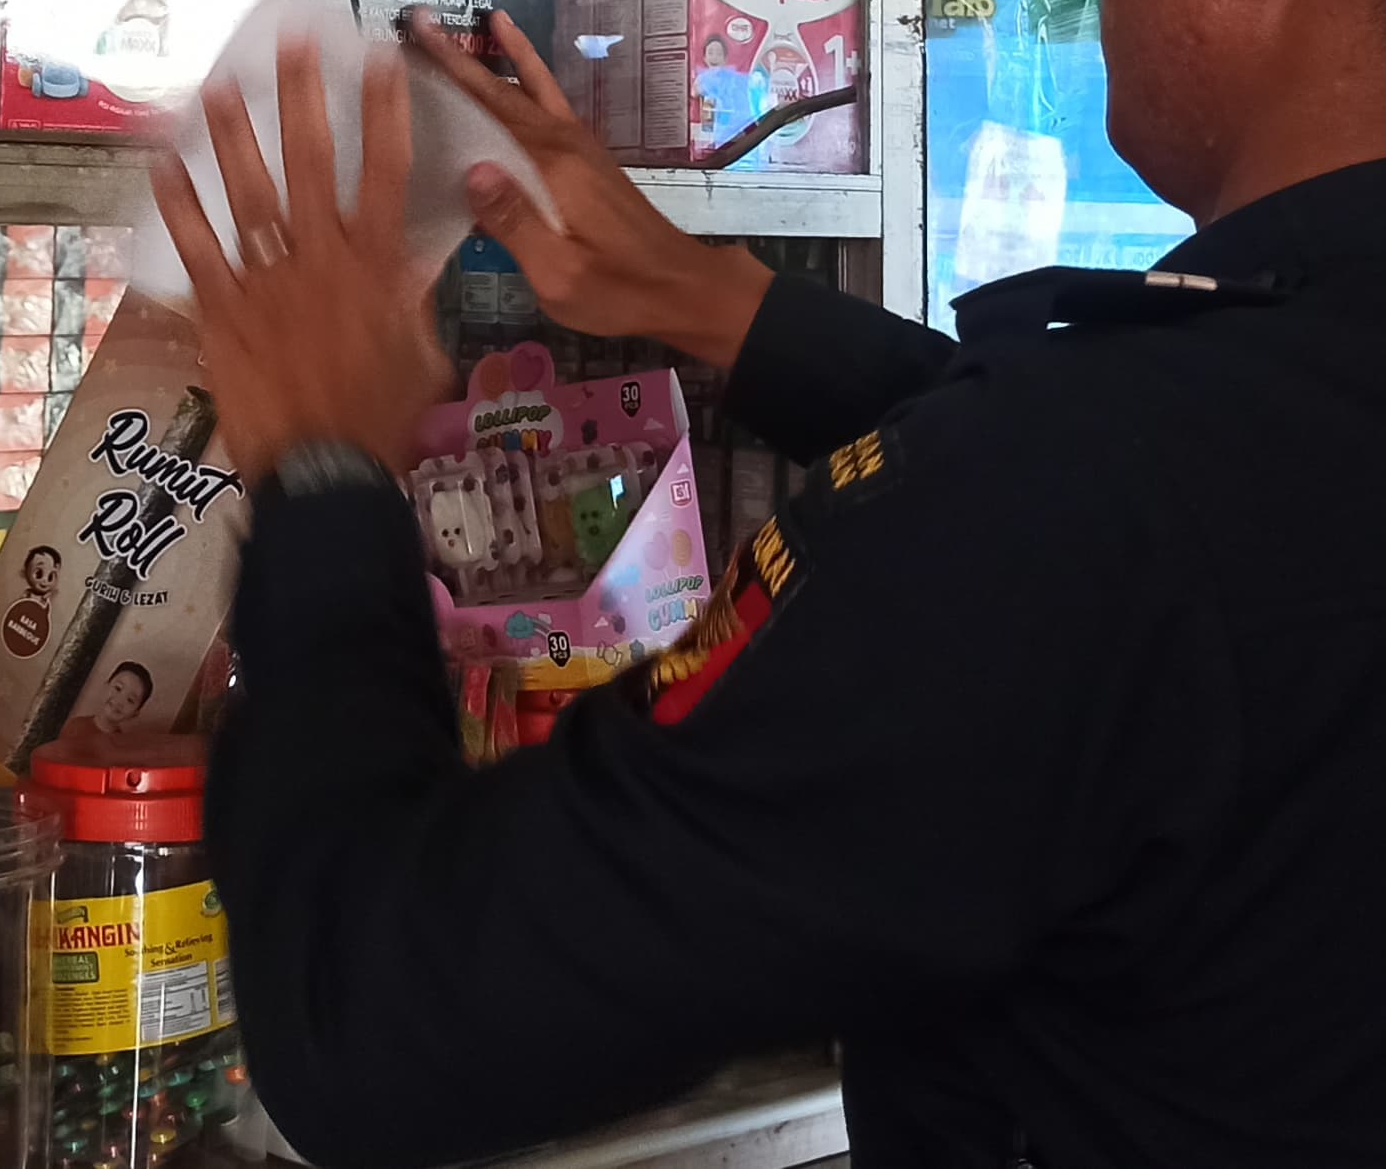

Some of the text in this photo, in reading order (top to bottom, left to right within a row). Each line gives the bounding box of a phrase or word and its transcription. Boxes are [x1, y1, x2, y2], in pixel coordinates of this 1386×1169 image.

[823, 34, 861, 89] 1+
[622, 386, 638, 402] 30
[474, 405, 551, 432] LOLLIPOP
[90, 409, 244, 521] Rumut
[78, 490, 188, 581] Roll
[85, 576, 118, 603] GURIH
[134, 591, 168, 606] LEZAT
[645, 575, 704, 603] LOLLIPOP
[648, 597, 698, 631] GUMM
[550, 636, 569, 653] 30
[58, 922, 143, 950] KANGIN
[151, 953, 193, 967] Sensation
